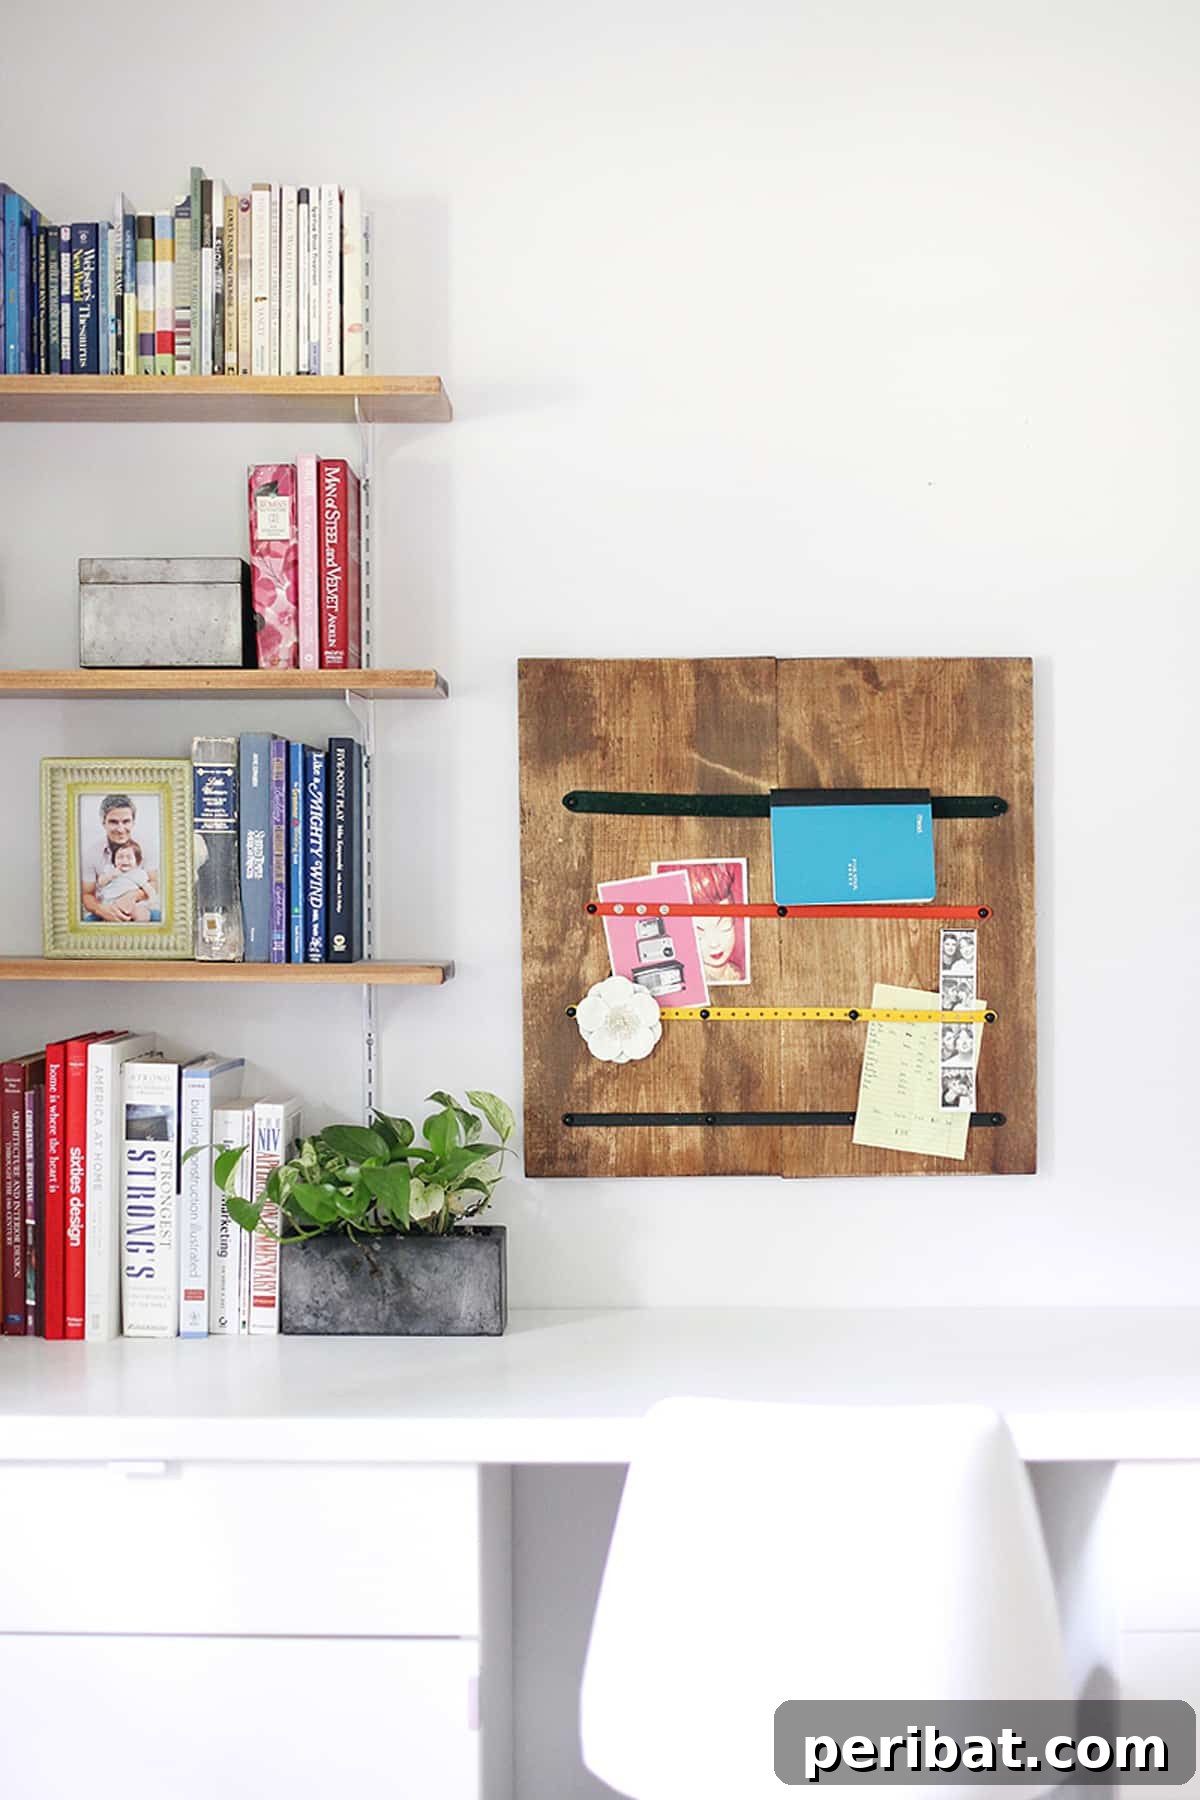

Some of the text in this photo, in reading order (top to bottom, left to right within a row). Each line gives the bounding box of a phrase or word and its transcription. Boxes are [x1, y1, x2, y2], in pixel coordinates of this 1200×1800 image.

[83, 248, 96, 302] Webster's
[79, 304, 91, 369] Thesaurus
[325, 510, 341, 547] STEEL
[325, 566, 342, 612] VELVET
[312, 752, 326, 776] Like
[308, 783, 323, 858] MIGHTY
[336, 800, 345, 822] PLAY
[308, 860, 323, 909] WIND
[49, 1063, 61, 1193] home is where the heart is
[92, 1065, 105, 1192] AMERICA AT HOME
[188, 1099, 205, 1145] building
[258, 1127, 281, 1152] NIV
[66, 1146, 85, 1247] sixties design
[159, 1150, 174, 1250] STRONGEST
[190, 1153, 201, 1220] onstruction
[126, 1149, 157, 1279] STRONG'S
[190, 1224, 203, 1278] illustrated
